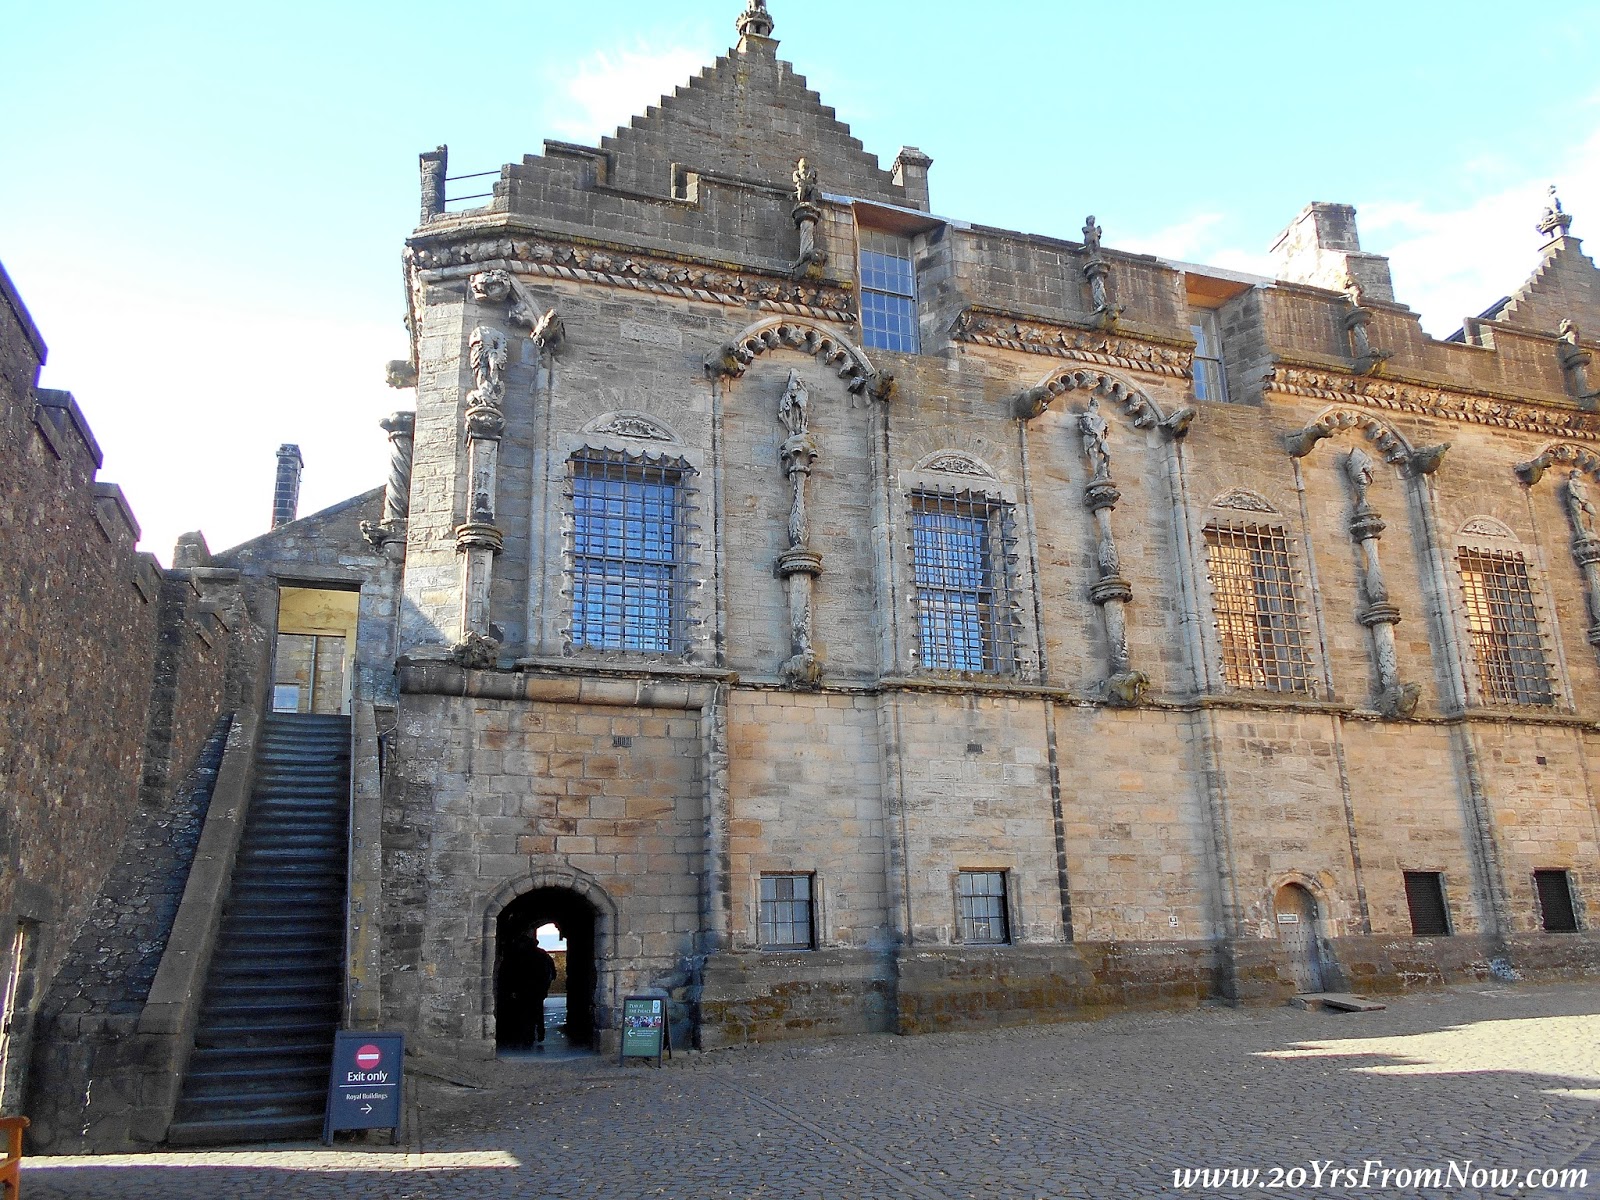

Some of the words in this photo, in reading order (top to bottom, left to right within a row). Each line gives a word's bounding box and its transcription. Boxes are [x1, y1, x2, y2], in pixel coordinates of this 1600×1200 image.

[347, 1071, 366, 1082] Exit
[367, 1070, 388, 1083] only
[362, 1092, 388, 1100] Buildings
